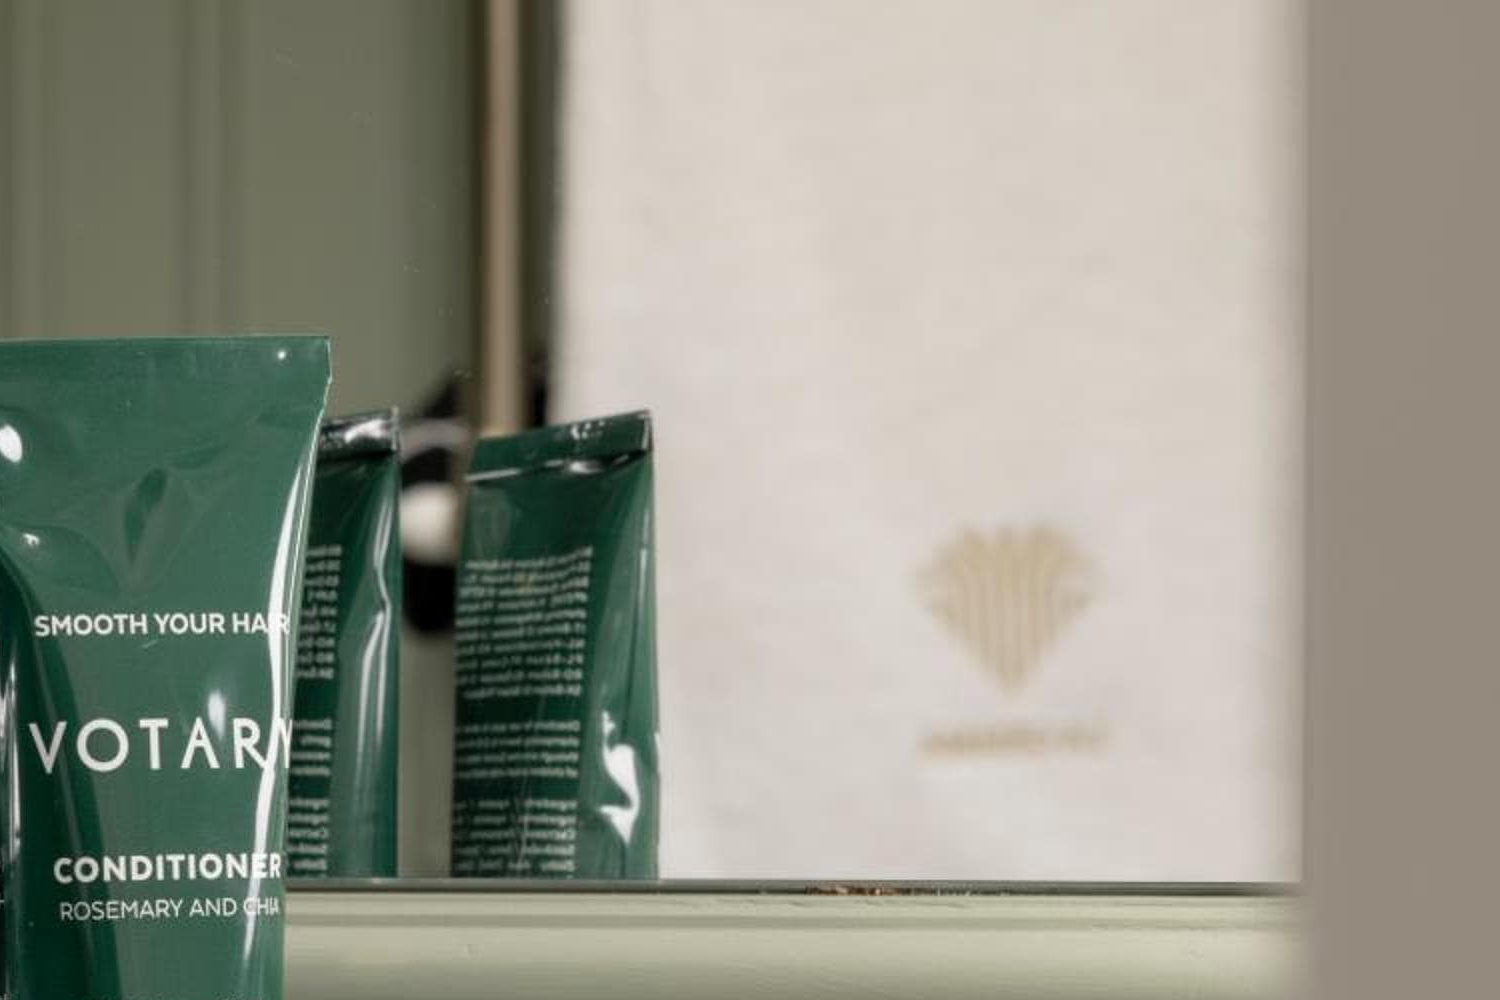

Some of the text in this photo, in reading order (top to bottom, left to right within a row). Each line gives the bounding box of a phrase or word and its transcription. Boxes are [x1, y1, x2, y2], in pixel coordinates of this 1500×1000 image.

[34, 613, 148, 637] SMOOTH
[153, 612, 225, 635] YOUR
[53, 852, 282, 884] CONDITIONER
[60, 899, 183, 921] ROSEMARY
[189, 898, 237, 917] AND
